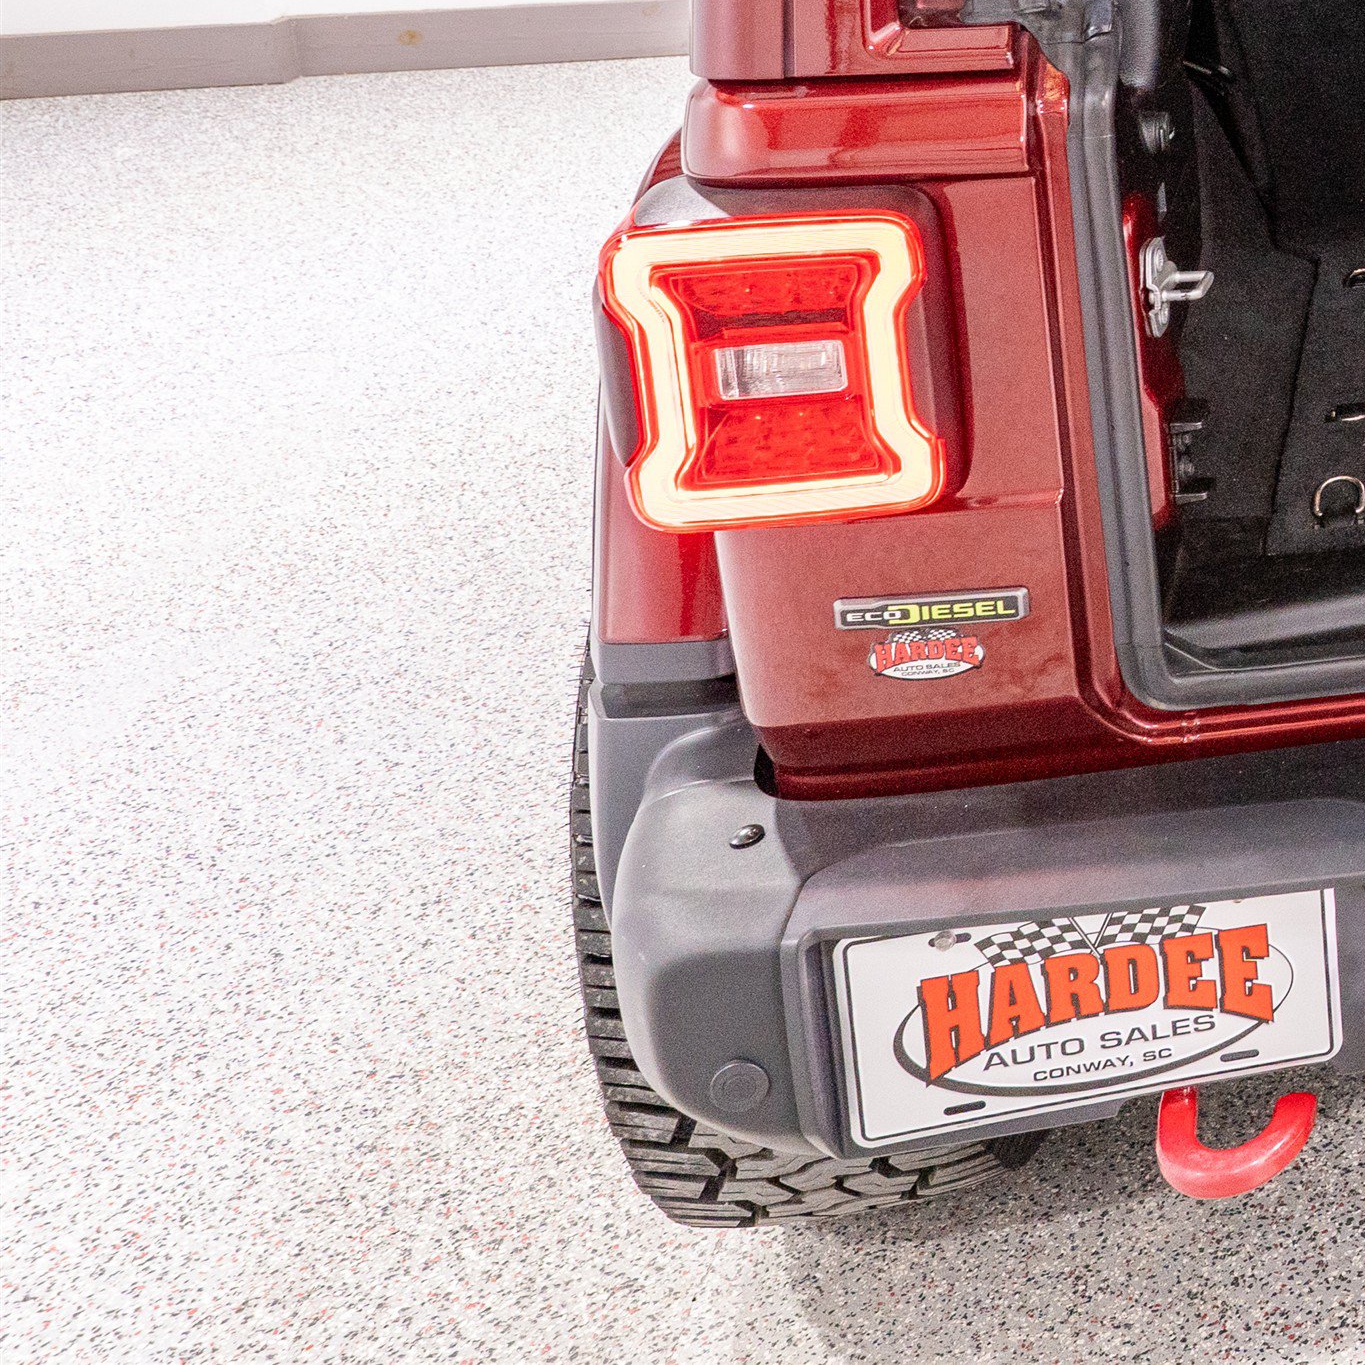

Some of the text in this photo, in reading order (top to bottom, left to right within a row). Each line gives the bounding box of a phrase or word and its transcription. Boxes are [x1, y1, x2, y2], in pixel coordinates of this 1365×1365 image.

[873, 636, 980, 673] HARDEE
[917, 923, 1275, 1088] HARDEE
[983, 1014, 1217, 1072] AUTO SALES
[1033, 1047, 1173, 1083] CONWAY, SC
